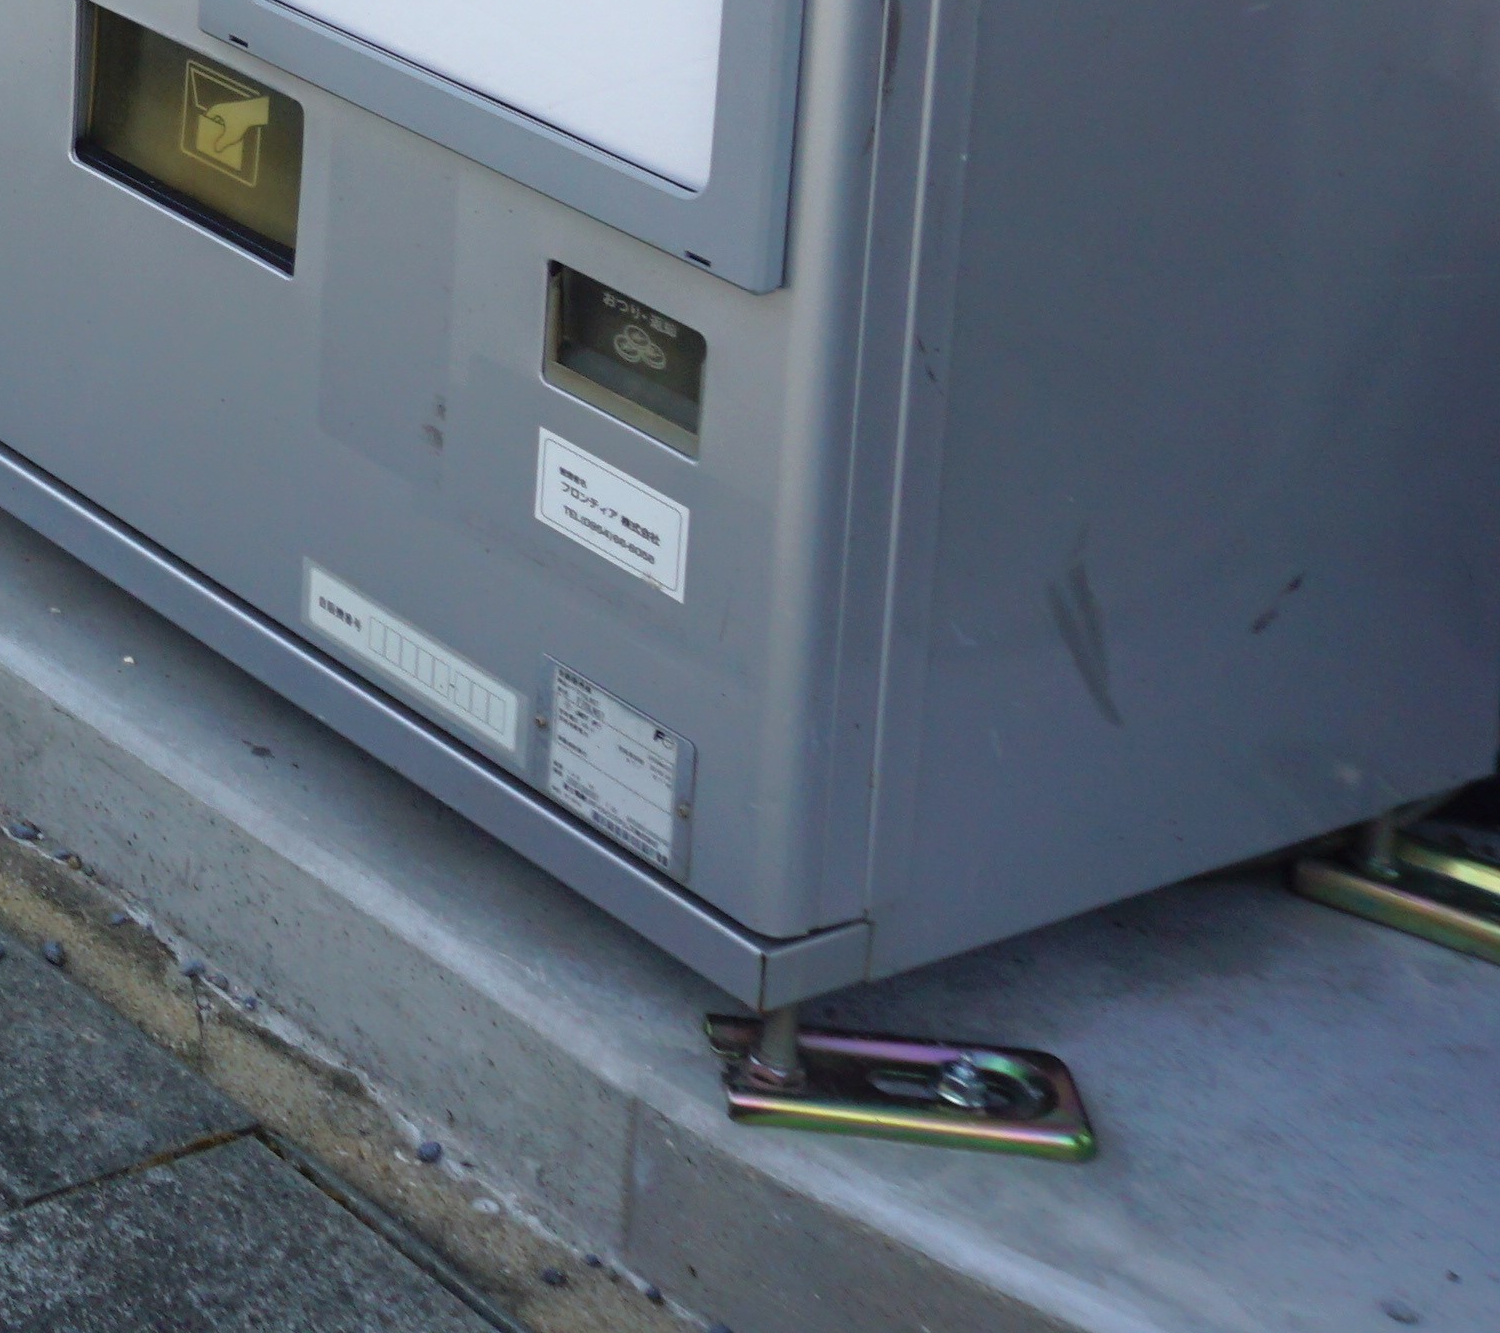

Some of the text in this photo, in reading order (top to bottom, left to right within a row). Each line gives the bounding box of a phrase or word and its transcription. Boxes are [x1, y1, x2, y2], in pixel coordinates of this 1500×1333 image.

[560, 481, 619, 518] フロンティア
